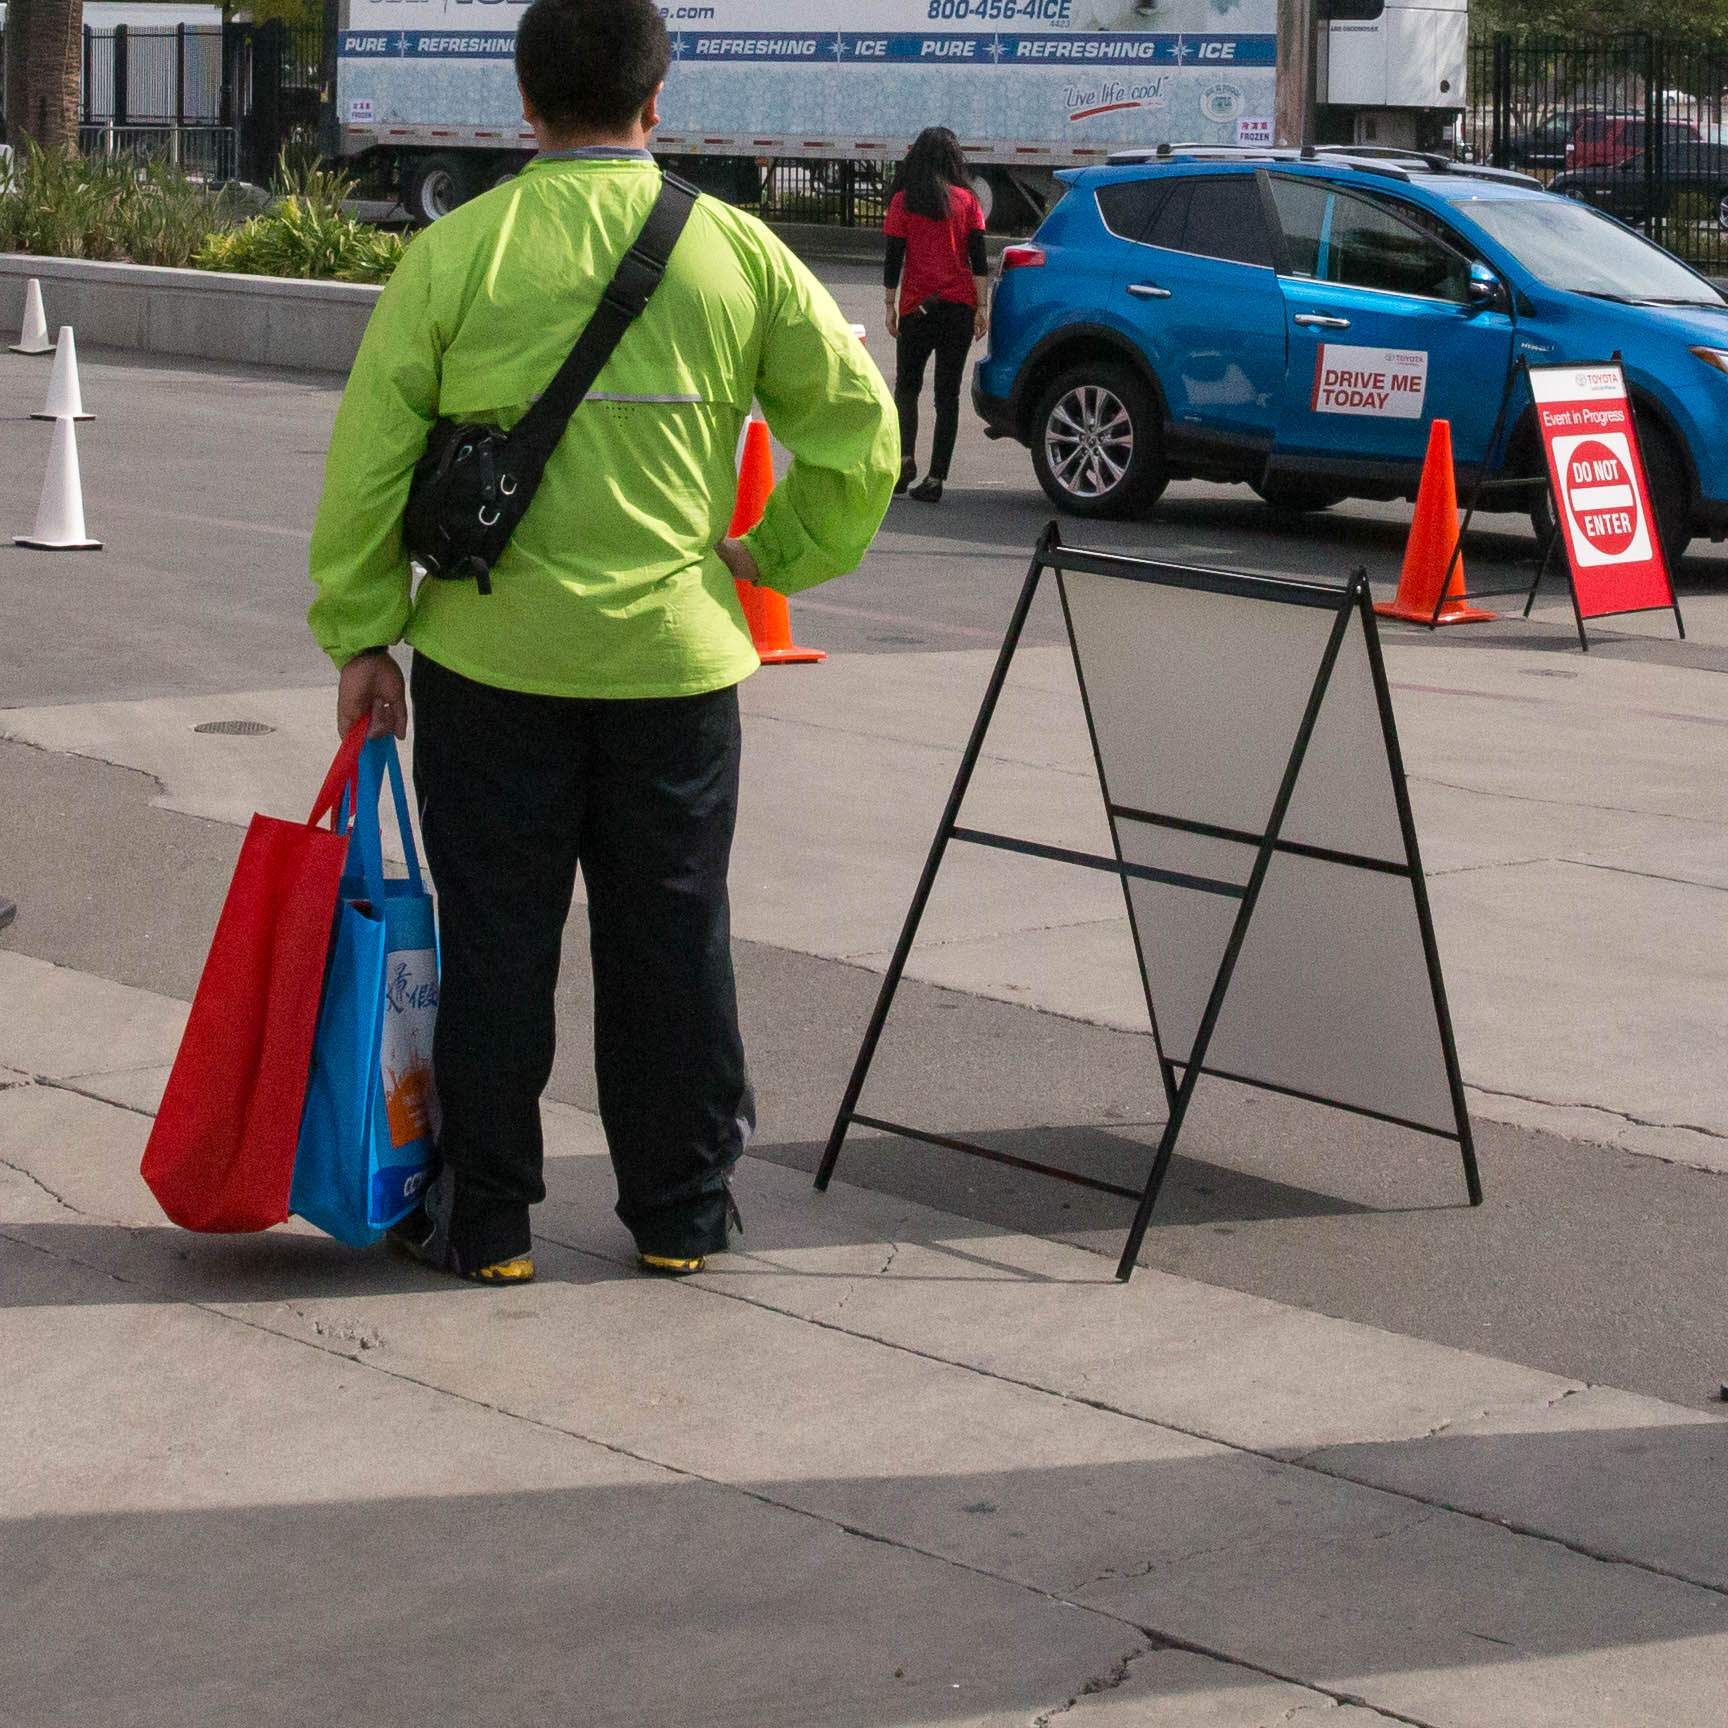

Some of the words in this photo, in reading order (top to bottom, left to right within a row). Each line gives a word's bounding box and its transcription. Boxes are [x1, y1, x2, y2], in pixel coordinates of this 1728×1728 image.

[344, 37, 387, 52] PURE
[695, 39, 817, 55] REFRESHING
[854, 40, 887, 56] ICE
[920, 40, 976, 57] PURE
[1016, 41, 1155, 58] REFRESHING
[1197, 42, 1237, 60] ICE
[1101, 82, 1125, 104] life
[1239, 132, 1270, 141] FROZEN
[1323, 369, 1385, 391] DRIVE
[1389, 374, 1423, 393] ME
[1587, 373, 1619, 385] TOYOTA
[1322, 388, 1390, 410] TODAY
[1542, 410, 1571, 427] Event
[1572, 409, 1582, 425] in
[1582, 408, 1625, 427] Progress
[1572, 461, 1593, 484] DO
[1594, 459, 1620, 482] NOT
[1584, 512, 1632, 537] ENTER
